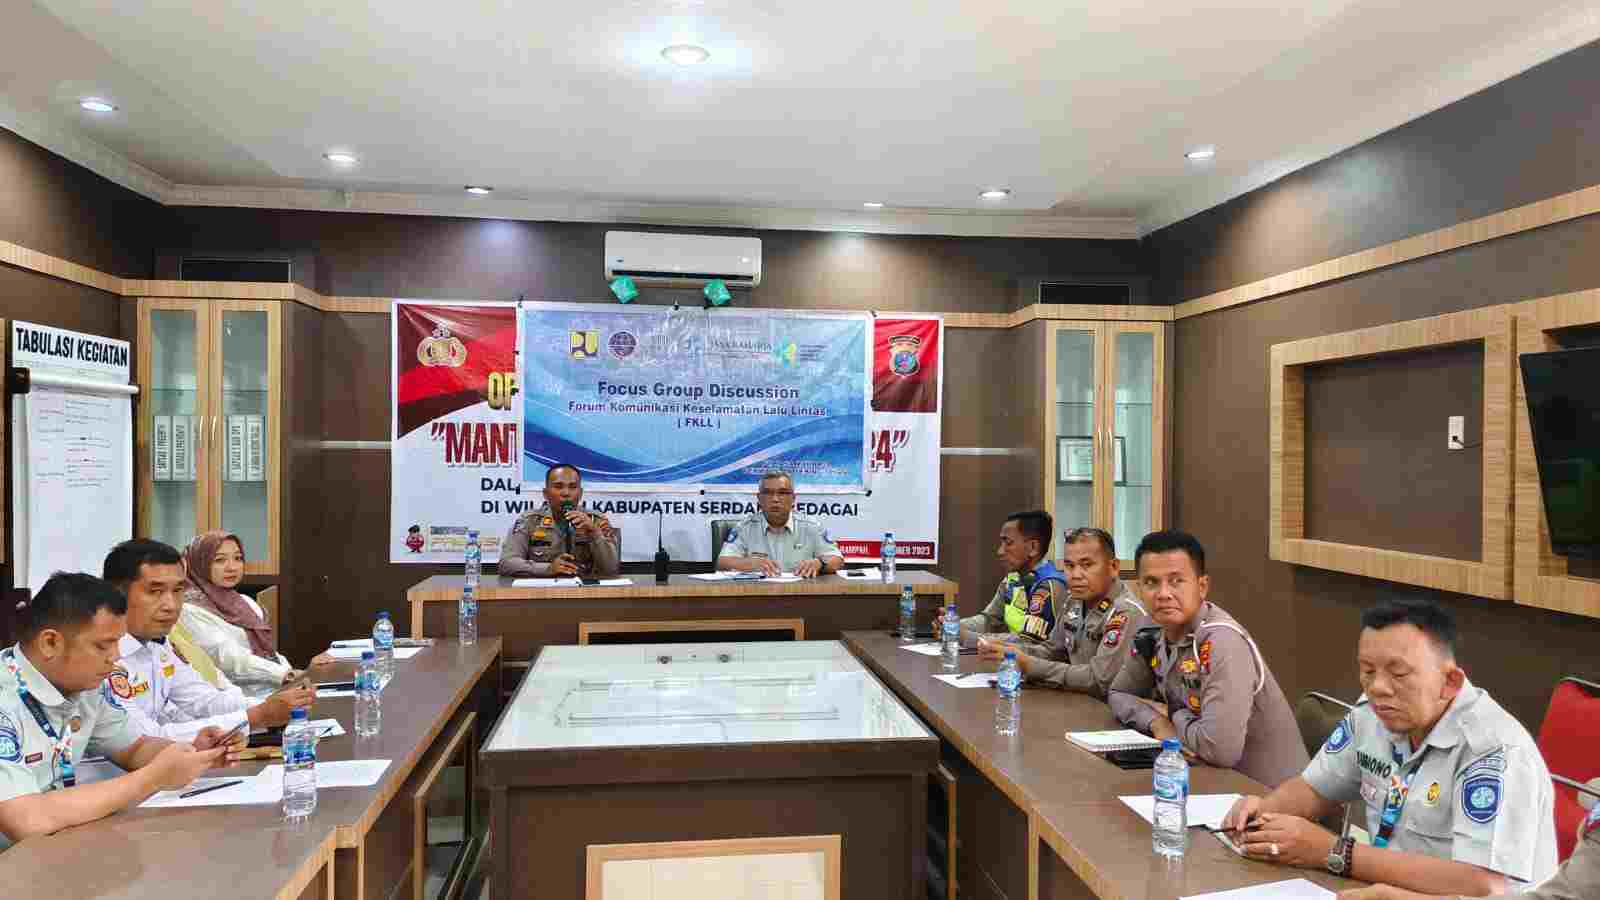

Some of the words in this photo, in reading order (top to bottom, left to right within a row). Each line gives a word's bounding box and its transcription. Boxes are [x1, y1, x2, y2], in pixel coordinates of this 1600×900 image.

[15, 327, 74, 359] TABULASI
[77, 338, 128, 367] KEGIATAN
[598, 381, 647, 396] Focus
[653, 382, 703, 401] Group
[709, 383, 799, 399] Discussion
[568, 400, 607, 412] Forum
[610, 402, 680, 413] Komunikasi
[683, 403, 760, 415] Keselamatan
[763, 405, 787, 416] Lalu
[791, 405, 826, 417] Lintas
[431, 422, 518, 466] "MANT
[480, 477, 520, 492] DAL
[481, 500, 499, 515] DI
[592, 500, 696, 515] KABUPATEN
[792, 503, 859, 517] EDAGAI
